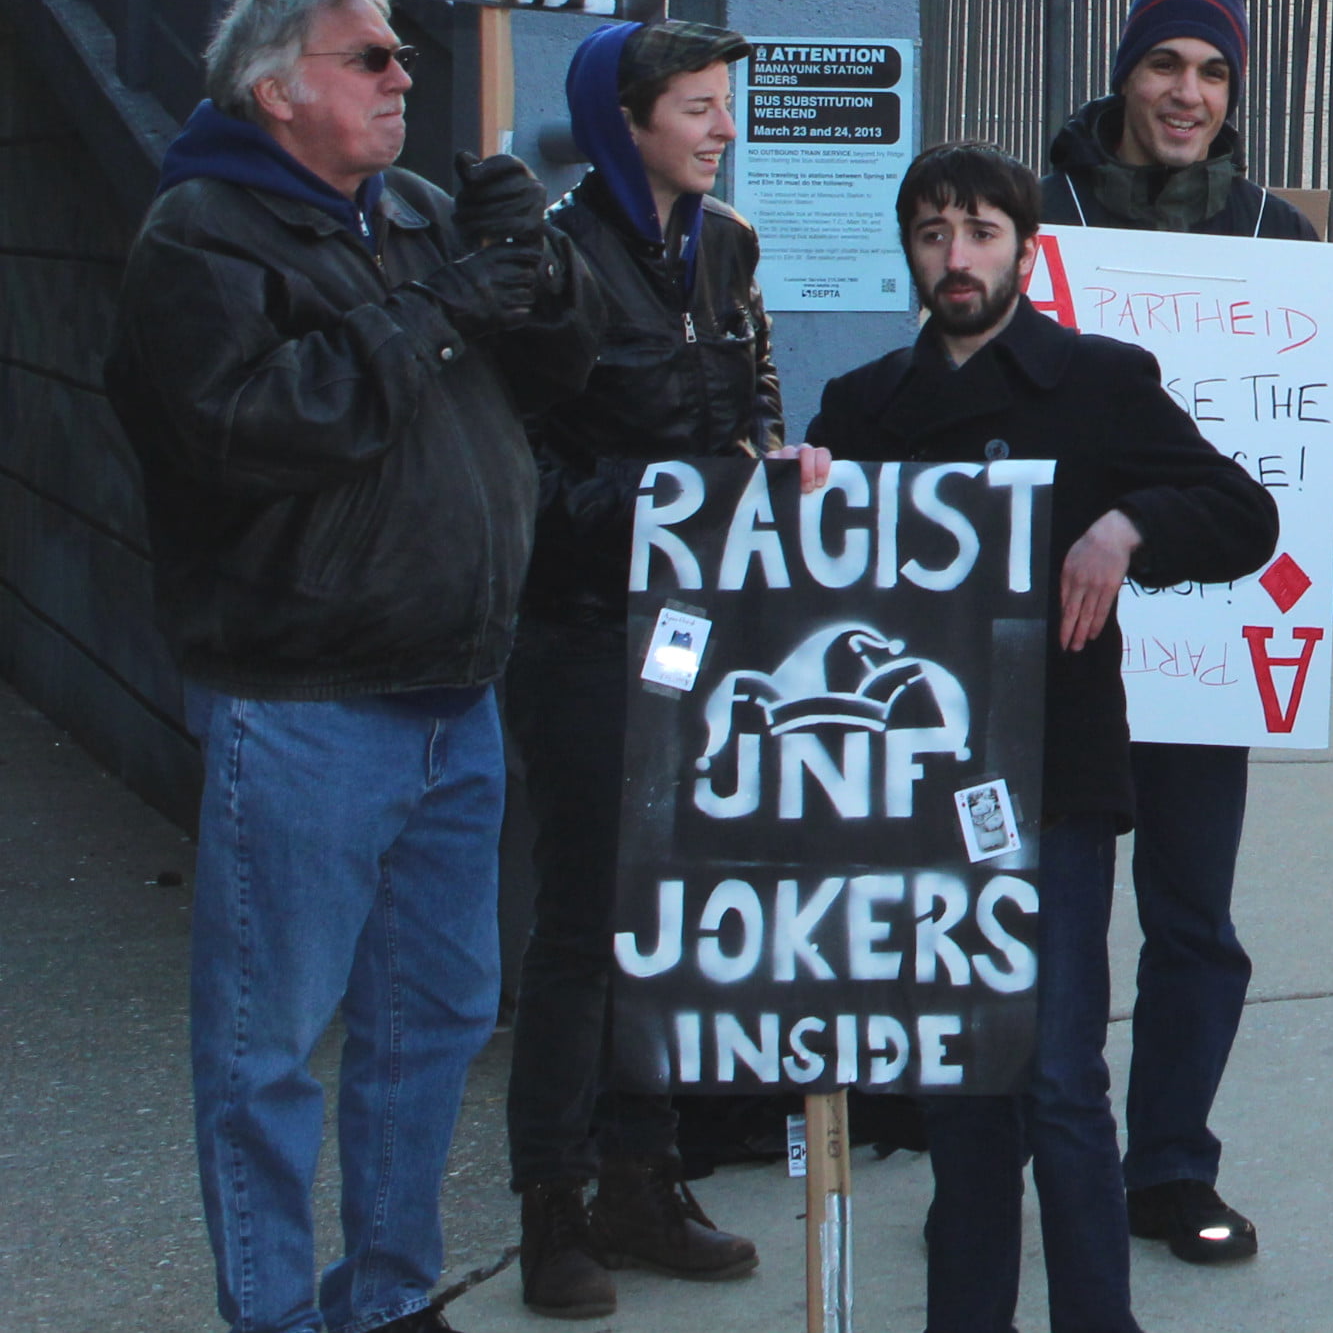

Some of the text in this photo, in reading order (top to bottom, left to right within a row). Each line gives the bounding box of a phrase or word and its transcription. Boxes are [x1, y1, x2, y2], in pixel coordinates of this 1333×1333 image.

[771, 47, 885, 63] ATTENTION
[754, 64, 873, 75] MANAYUNK STATION
[754, 75, 798, 85] RIDERS
[754, 95, 873, 107] BUS SUBSTITUTION
[754, 108, 817, 119] WEEKEND
[754, 125, 790, 136] March
[793, 126, 807, 136] 23
[810, 127, 831, 137] and
[855, 127, 882, 138] 2013
[812, 290, 840, 298] SEPTA
[1240, 373, 1331, 423] THE
[628, 459, 1057, 593] RACIST
[693, 728, 926, 820] JNF
[613, 874, 1040, 994] JOKERS
[674, 1013, 964, 1085] INSIDE
